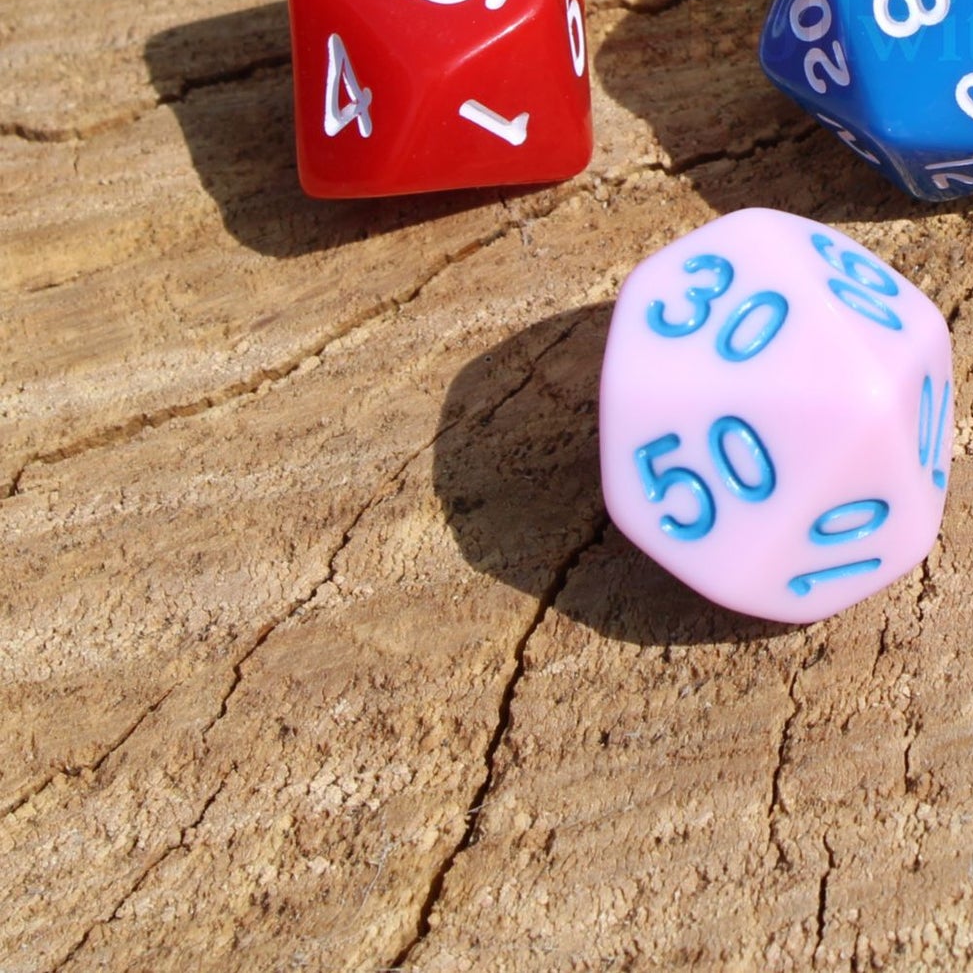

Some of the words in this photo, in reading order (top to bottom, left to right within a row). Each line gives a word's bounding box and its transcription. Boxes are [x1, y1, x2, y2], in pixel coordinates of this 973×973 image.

[323, 33, 373, 138] 4
[458, 99, 530, 146] 1
[646, 253, 789, 363] 30
[634, 415, 777, 542] 50
[788, 498, 890, 596] 10
